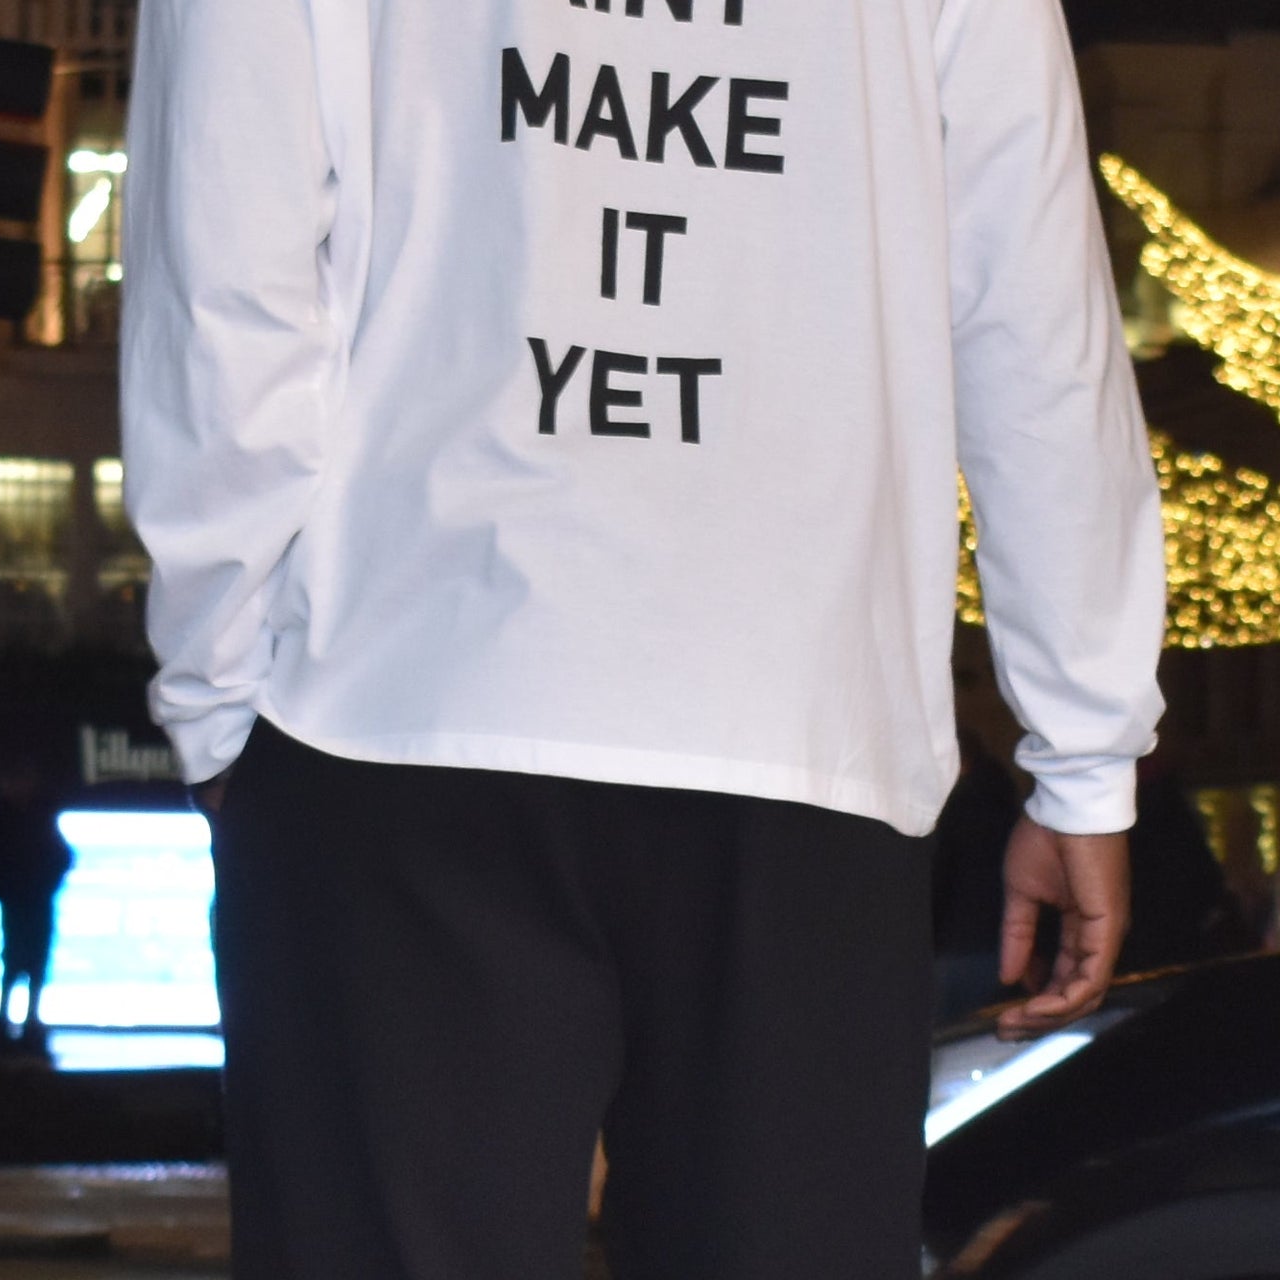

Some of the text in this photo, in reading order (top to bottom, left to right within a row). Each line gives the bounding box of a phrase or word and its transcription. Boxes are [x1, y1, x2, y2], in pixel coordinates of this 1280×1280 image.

[501, 47, 789, 174] MAKE
[600, 207, 687, 306] IT
[527, 337, 722, 444] YET
